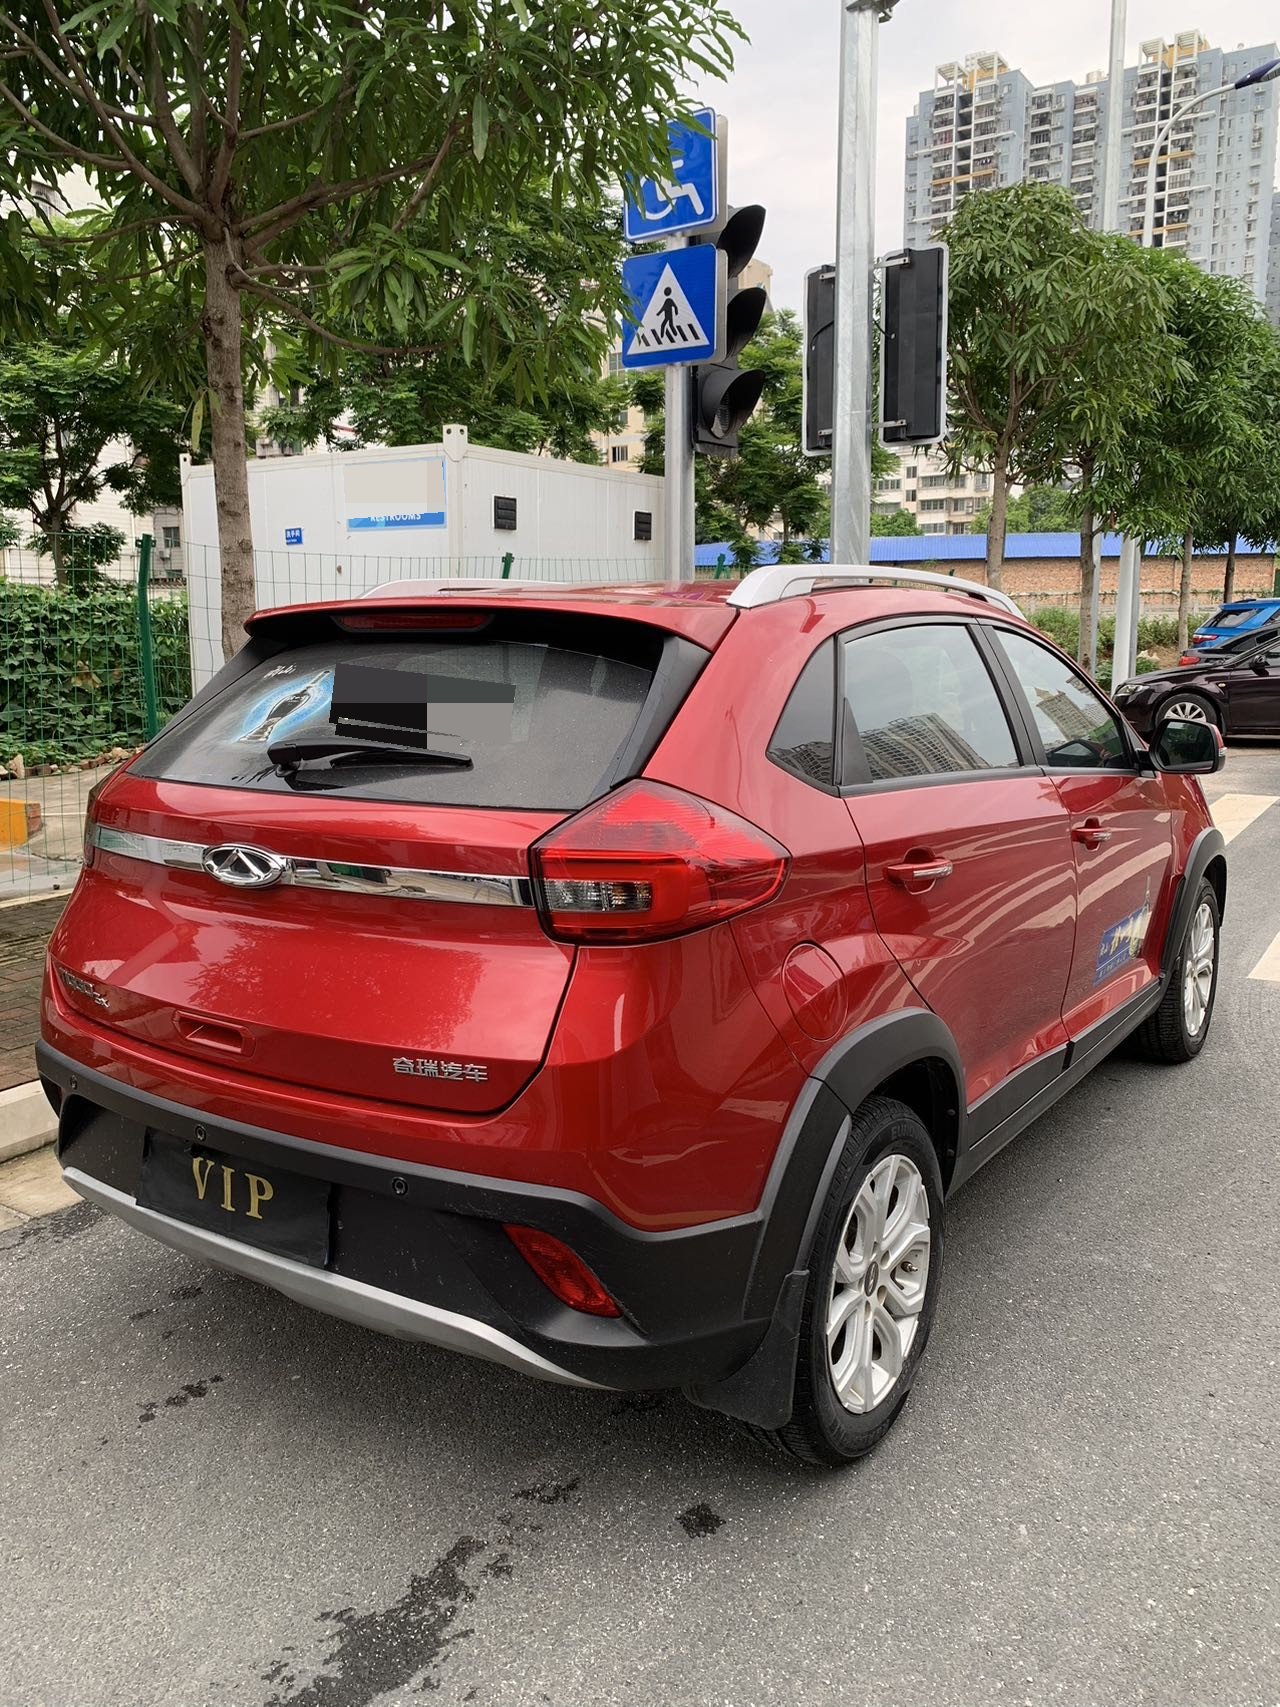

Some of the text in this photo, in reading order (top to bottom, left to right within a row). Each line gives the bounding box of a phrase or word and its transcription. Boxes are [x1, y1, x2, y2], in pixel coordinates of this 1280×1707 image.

[393, 1057, 488, 1081] 奇瑞汽车
[192, 1156, 274, 1219] VIP
